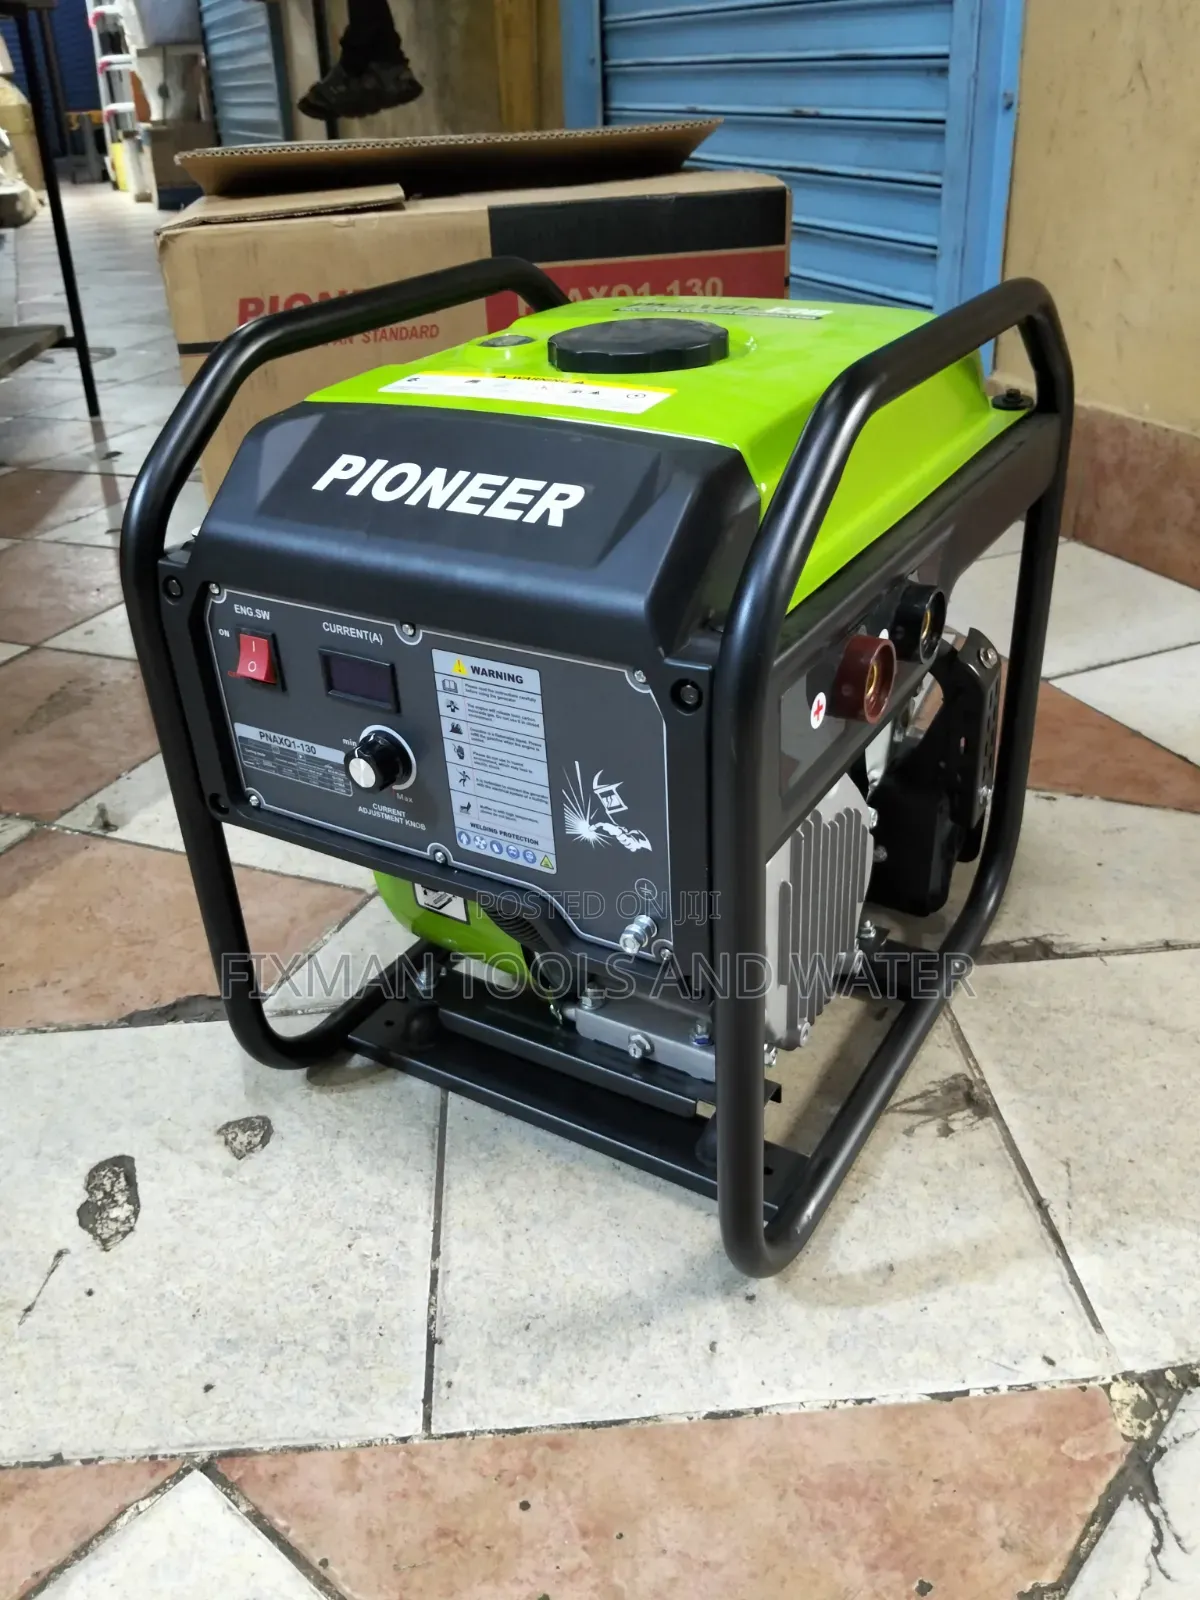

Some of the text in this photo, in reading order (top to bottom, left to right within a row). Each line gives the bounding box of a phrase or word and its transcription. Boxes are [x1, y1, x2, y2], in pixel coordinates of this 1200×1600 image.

[363, 324, 439, 344] STANDARD
[311, 453, 585, 528] PIONEER
[233, 604, 271, 621] ENG.SW
[218, 628, 230, 638] ON
[322, 621, 384, 646] CURRENT(A)
[470, 665, 524, 685] WARNING
[259, 731, 317, 755] PNAXQ1-130
[342, 738, 358, 748] min
[396, 792, 414, 804] Max
[357, 805, 427, 831] ADJUSTMENT KNOB
[372, 802, 406, 818] CURRENT
[469, 822, 539, 846] WELDING PROTECTION
